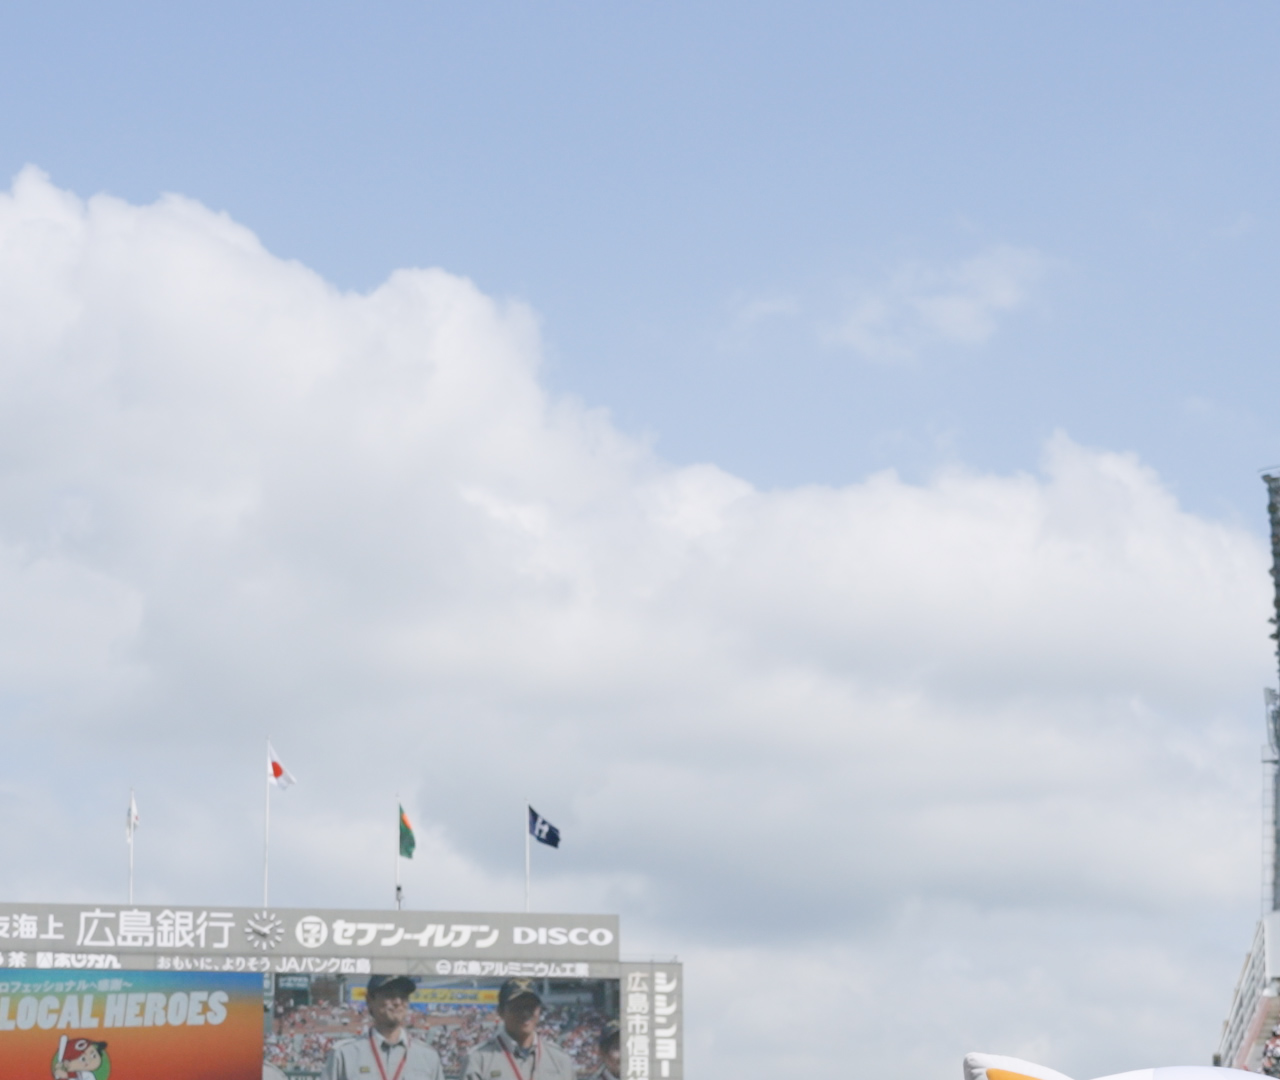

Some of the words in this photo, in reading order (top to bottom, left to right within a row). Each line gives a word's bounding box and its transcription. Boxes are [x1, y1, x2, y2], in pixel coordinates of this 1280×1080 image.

[77, 909, 236, 948] 広島銀行
[513, 927, 613, 947] DISCO
[104, 990, 229, 1028] HEROES
